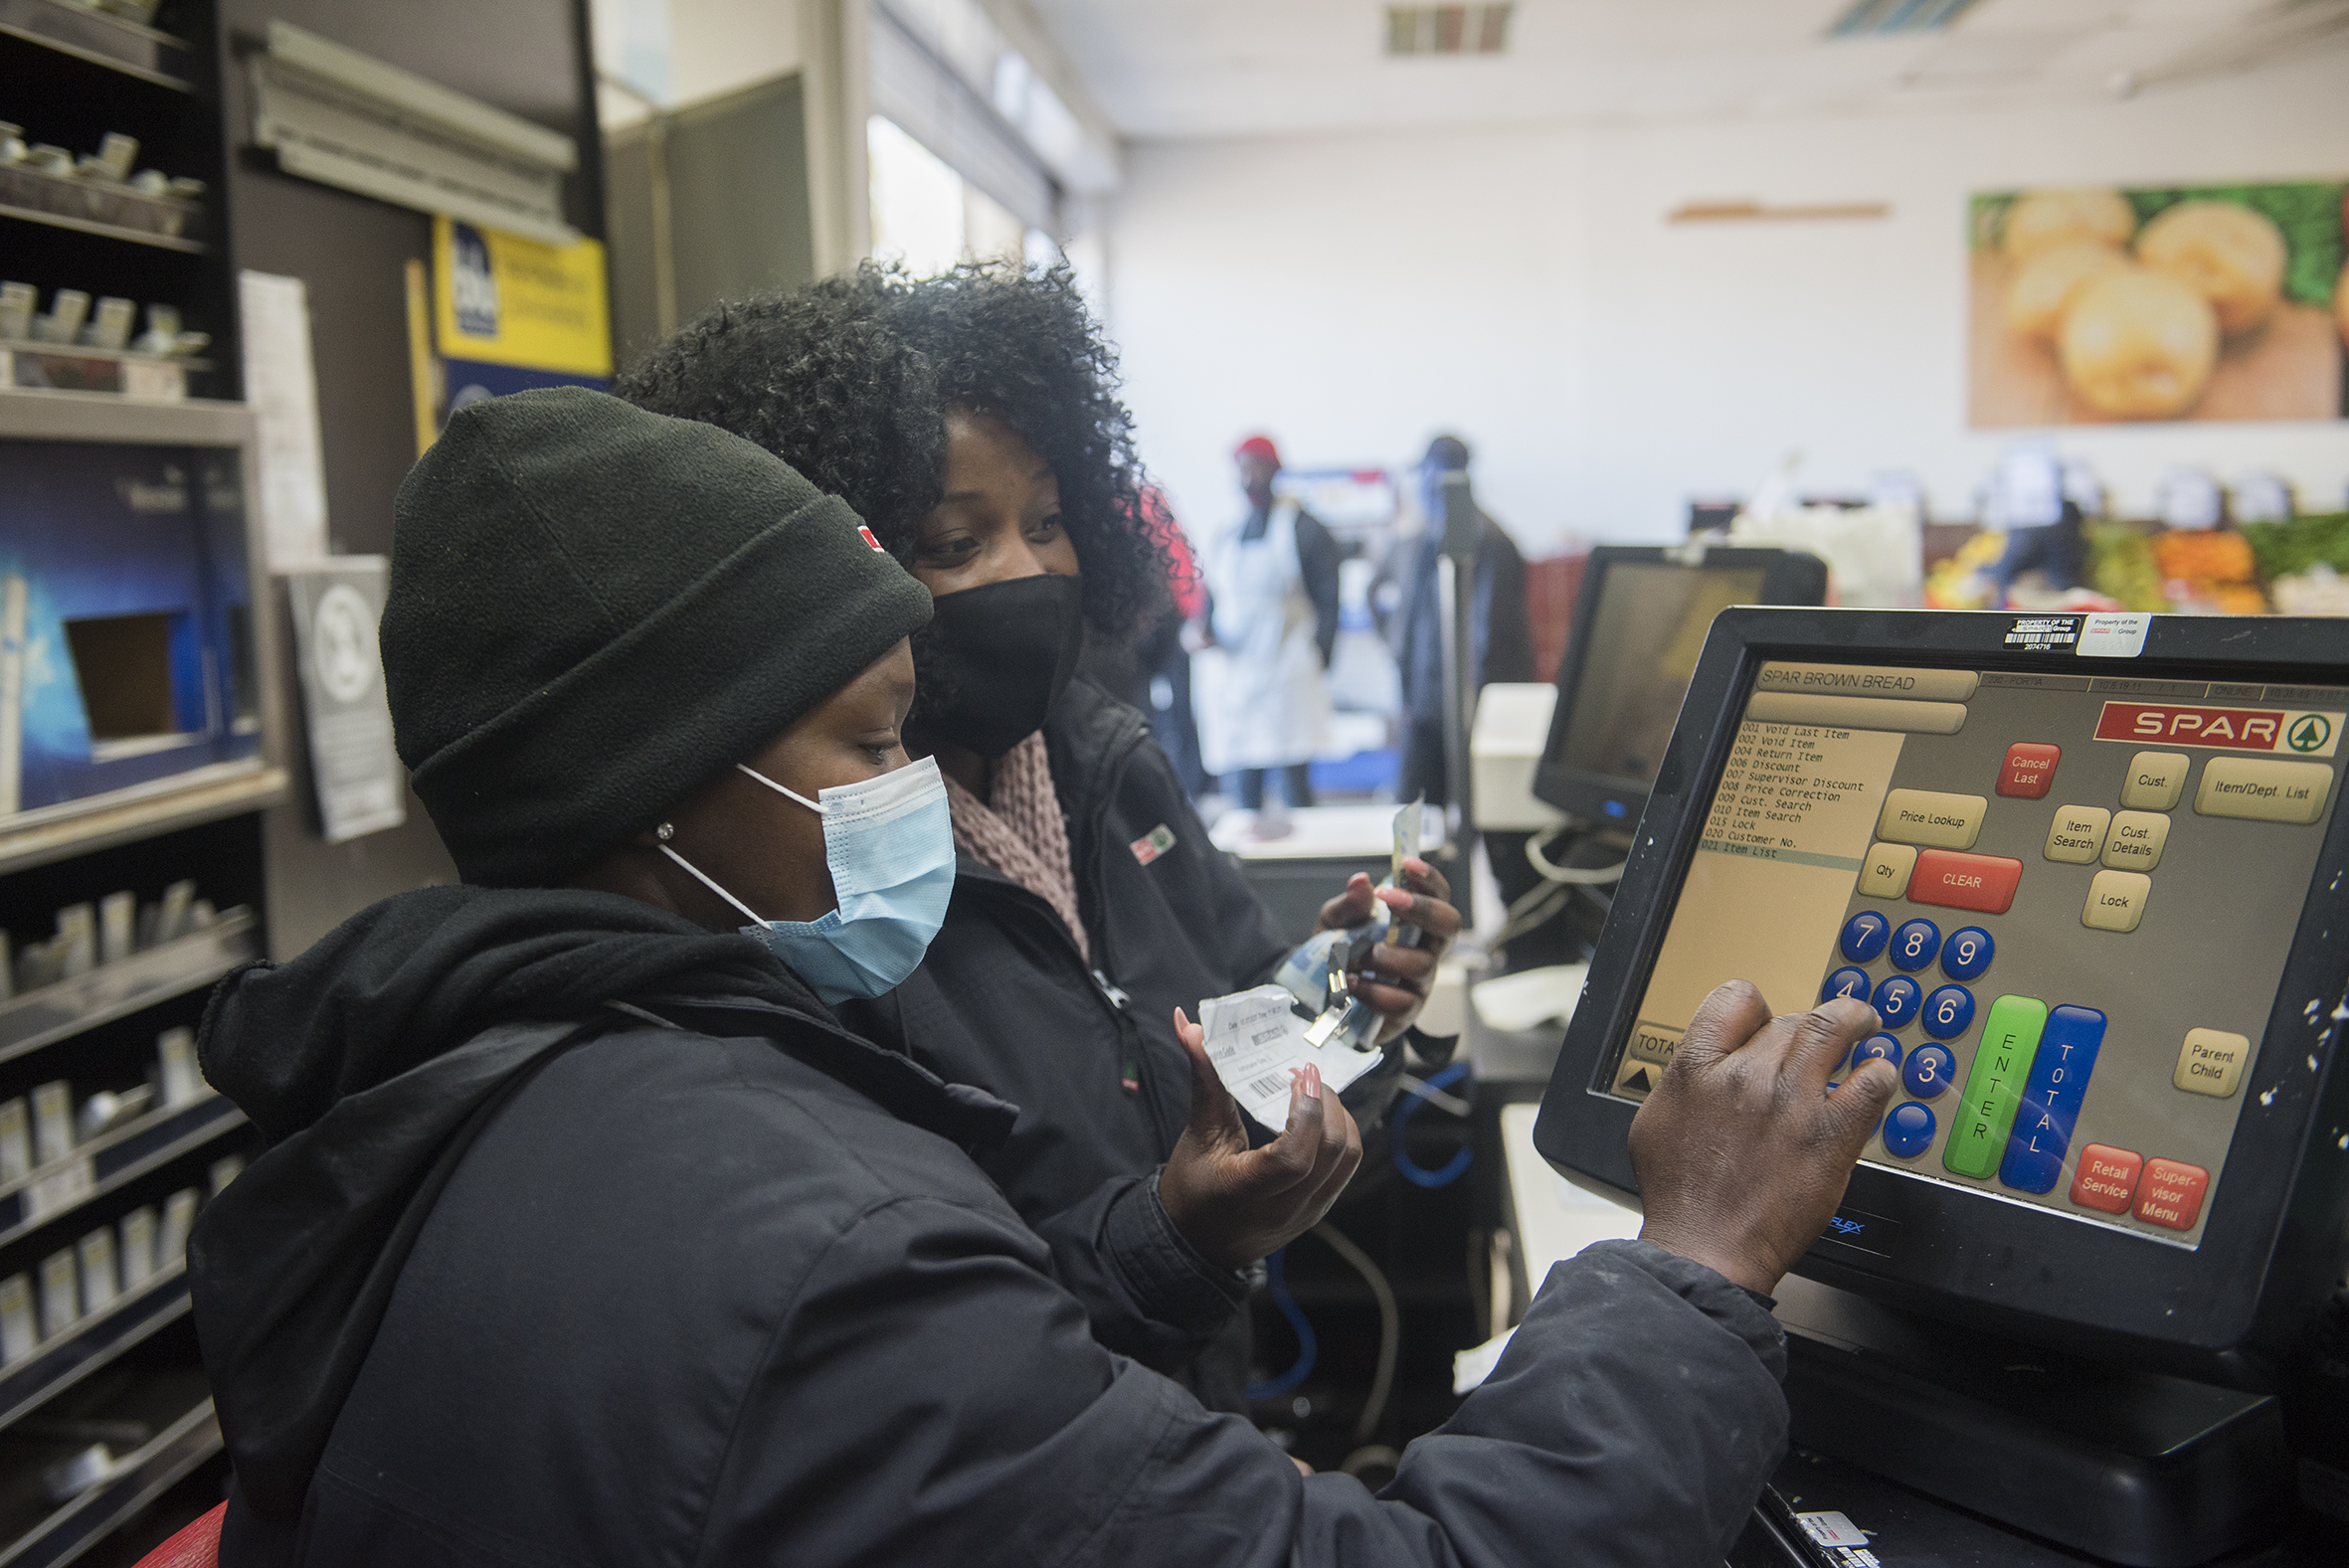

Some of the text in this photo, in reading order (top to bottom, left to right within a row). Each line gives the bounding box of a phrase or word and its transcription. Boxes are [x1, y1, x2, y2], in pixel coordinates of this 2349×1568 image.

[1761, 669, 1915, 691] SPAR BROWN BREAD
[1742, 723, 1850, 740] 001 Void Last Item
[2133, 711, 2276, 743] SPAR
[1738, 734, 1815, 750] 002 Void Item
[1734, 746, 1823, 763] 004 Return Item
[2012, 756, 2051, 770] Cancel
[1729, 758, 1801, 773] 006 Discount
[1725, 770, 1865, 792] 007 Supervisor Discount
[2014, 772, 2039, 784] Last
[2138, 774, 2168, 788] Cust.
[1721, 781, 1841, 802] 008 Price Correction
[2215, 780, 2310, 799] Item/Dept. List
[1717, 792, 1812, 812] 009 Cust. Search
[1714, 804, 1802, 823] 010 Item Search
[1899, 810, 1965, 829] Price Lookup
[1710, 816, 1756, 831] 015 Lock
[2066, 819, 2092, 834] Item
[2120, 825, 2151, 840] Cust.
[1706, 828, 1797, 848] 020 Customer No.
[2053, 835, 2094, 850] Search
[1701, 840, 1778, 859] 021 Item List
[2111, 841, 2153, 857] Details
[1876, 864, 1896, 879] Qty
[1942, 873, 1982, 888] CLEAR
[2099, 894, 2129, 909] Lock
[1856, 923, 1875, 949] 7
[1904, 932, 1923, 958] 8
[1957, 941, 1976, 965] 9
[1836, 980, 1855, 998] 4
[1886, 988, 1905, 1014] 5
[1937, 998, 1957, 1024] 6
[1638, 1034, 1675, 1056] TOTA
[2191, 1044, 2235, 1064] Parent
[1918, 1057, 1937, 1083] 3
[2190, 1063, 2224, 1080] Child
[1972, 1033, 2017, 1140] ENTER
[2091, 1160, 2129, 1181] Retail
[2152, 1166, 2197, 1187] Super-
[2081, 1177, 2128, 1199] Service
[2151, 1185, 2184, 1204] visor
[2141, 1203, 2179, 1222] Menu
